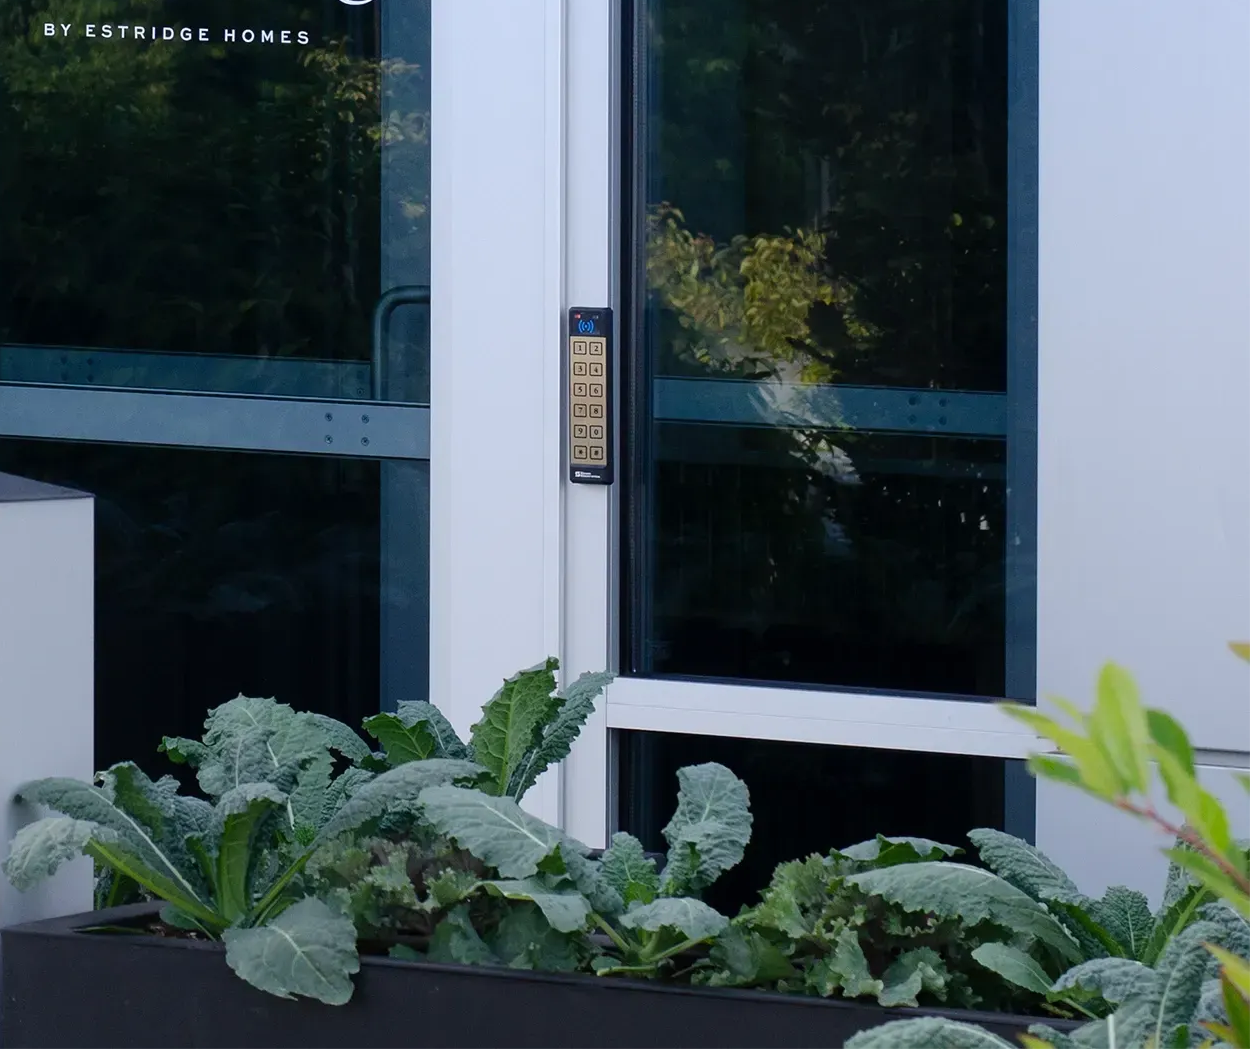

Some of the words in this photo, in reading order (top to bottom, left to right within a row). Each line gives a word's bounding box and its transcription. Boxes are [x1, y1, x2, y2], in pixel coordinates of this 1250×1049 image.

[44, 23, 72, 37] BY
[85, 24, 209, 42] ESTRIDGE
[224, 28, 309, 45] HOMES
